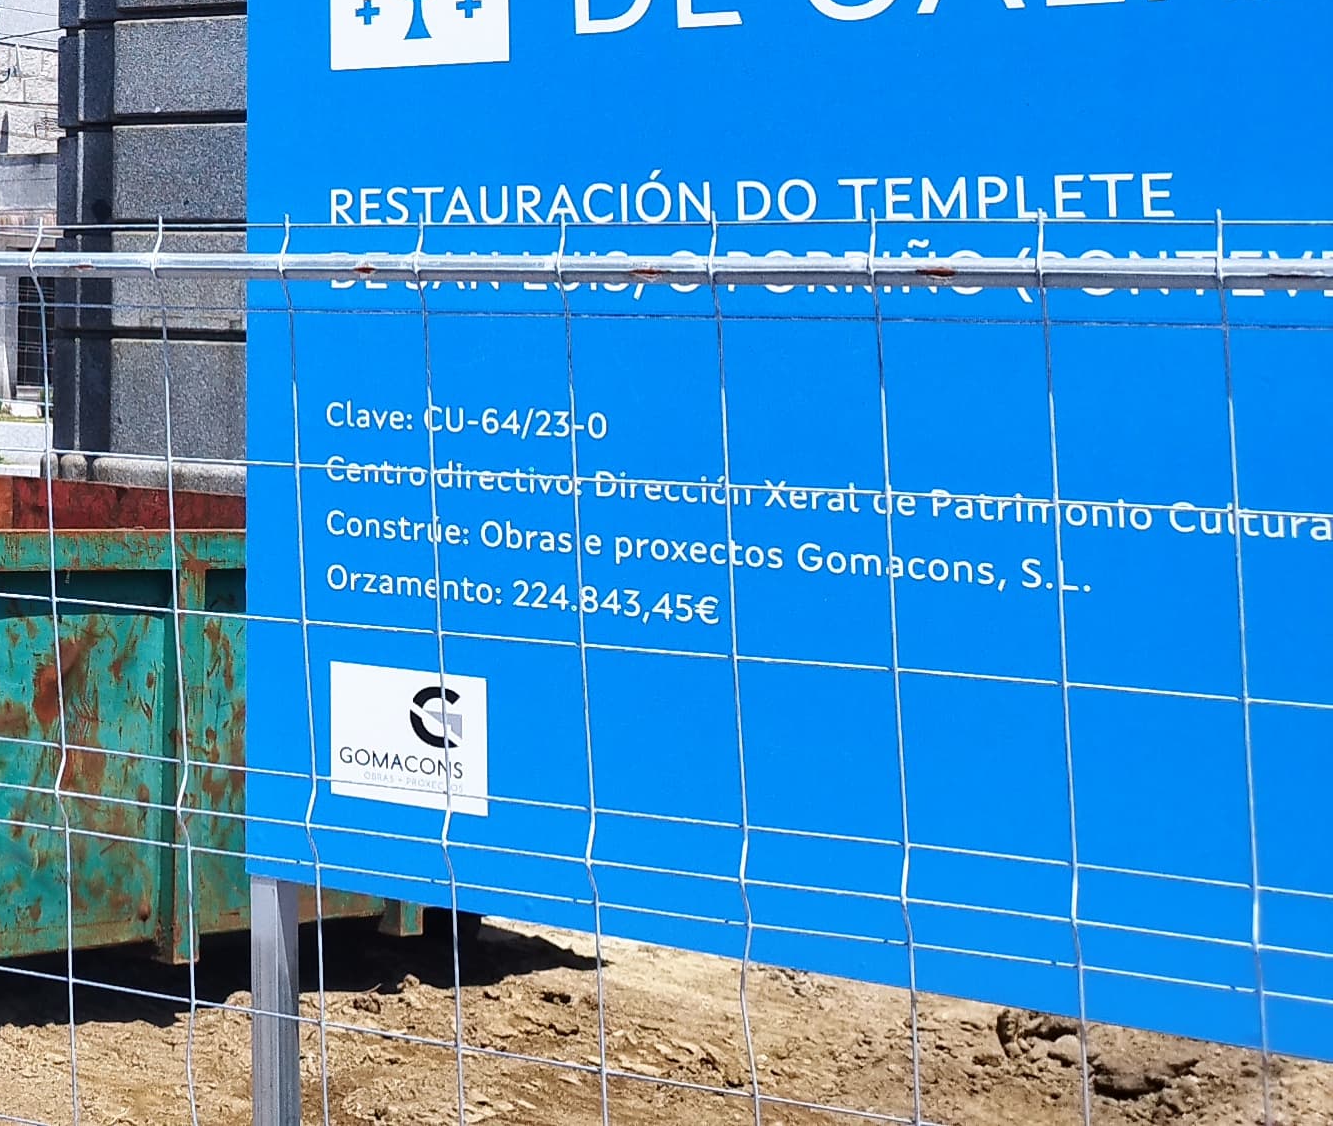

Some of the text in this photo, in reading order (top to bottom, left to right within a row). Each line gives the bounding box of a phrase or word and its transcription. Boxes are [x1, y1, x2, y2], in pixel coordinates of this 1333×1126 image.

[330, 168, 1176, 225] RESTAURACIÓN DO TEMPLETE
[325, 399, 608, 440] Clave: CU-64/23-0
[325, 455, 426, 487] Centro
[436, 459, 583, 496] directivo:
[594, 470, 752, 507] Dirección
[764, 479, 861, 514] Xeral
[872, 484, 916, 516] de
[931, 488, 1154, 532] Patrimonio
[480, 519, 573, 553] Obras
[584, 533, 603, 555] e
[614, 534, 784, 569] proxectos
[796, 542, 1007, 592] Gomacons,
[1020, 557, 1091, 593] S.L.
[326, 564, 721, 625] Orzamento: 224.843,45€
[339, 746, 464, 779] GOMACONS
